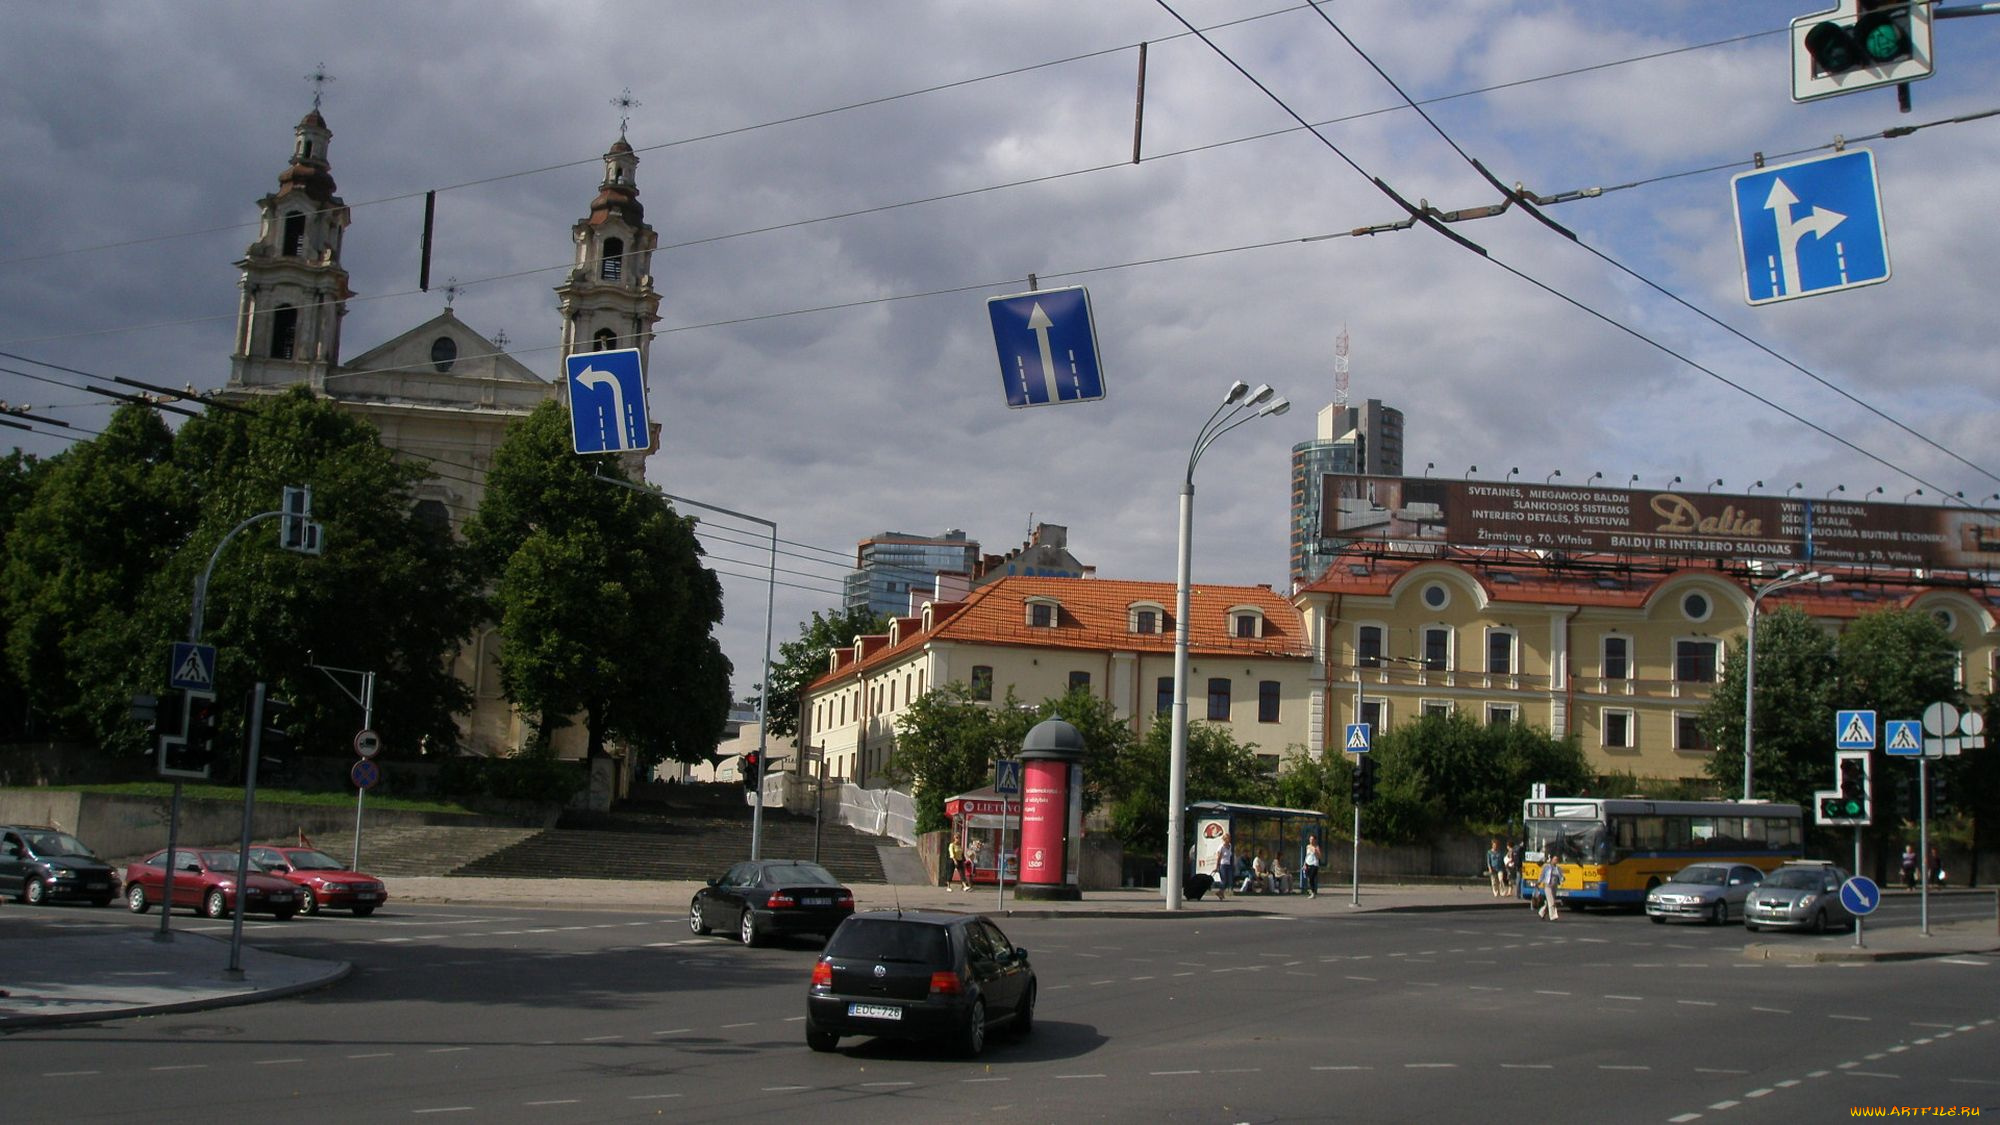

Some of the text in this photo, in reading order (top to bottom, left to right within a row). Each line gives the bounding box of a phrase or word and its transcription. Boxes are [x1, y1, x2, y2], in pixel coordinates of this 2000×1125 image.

[1468, 486, 1629, 503] SVETAINĖS, MIEGAMOJO BALDAI
[1513, 500, 1630, 515] SLANKIOSIOS SISTEMOS
[1650, 493, 1763, 537] Dalia
[1472, 509, 1630, 527] INTERJERO DETALĖS, ŠVIESTUVAI
[1525, 534, 1535, 544] g.
[1538, 533, 1554, 545] 70,
[1557, 533, 1593, 545] Vilnius
[1611, 536, 1792, 555] BALDŲ IR INTERJERO SALONAS
[1888, 551, 1922, 562] Vilnius
